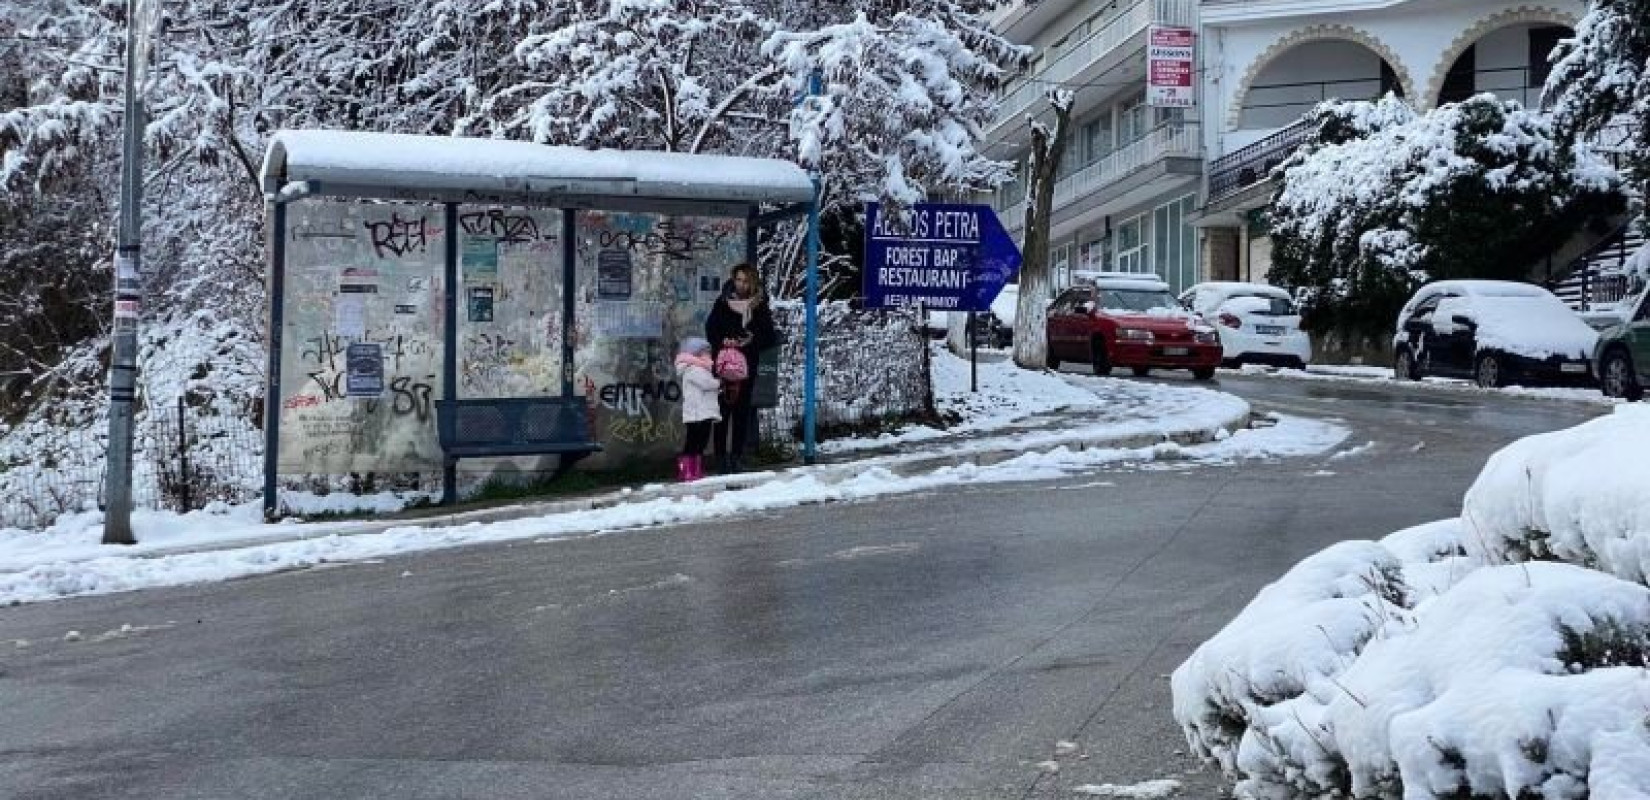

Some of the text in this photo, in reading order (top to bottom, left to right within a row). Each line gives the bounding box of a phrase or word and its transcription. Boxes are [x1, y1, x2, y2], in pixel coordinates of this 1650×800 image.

[934, 211, 980, 239] PETRA
[886, 246, 930, 267] FOREST
[878, 267, 969, 290] RESTAURANT
